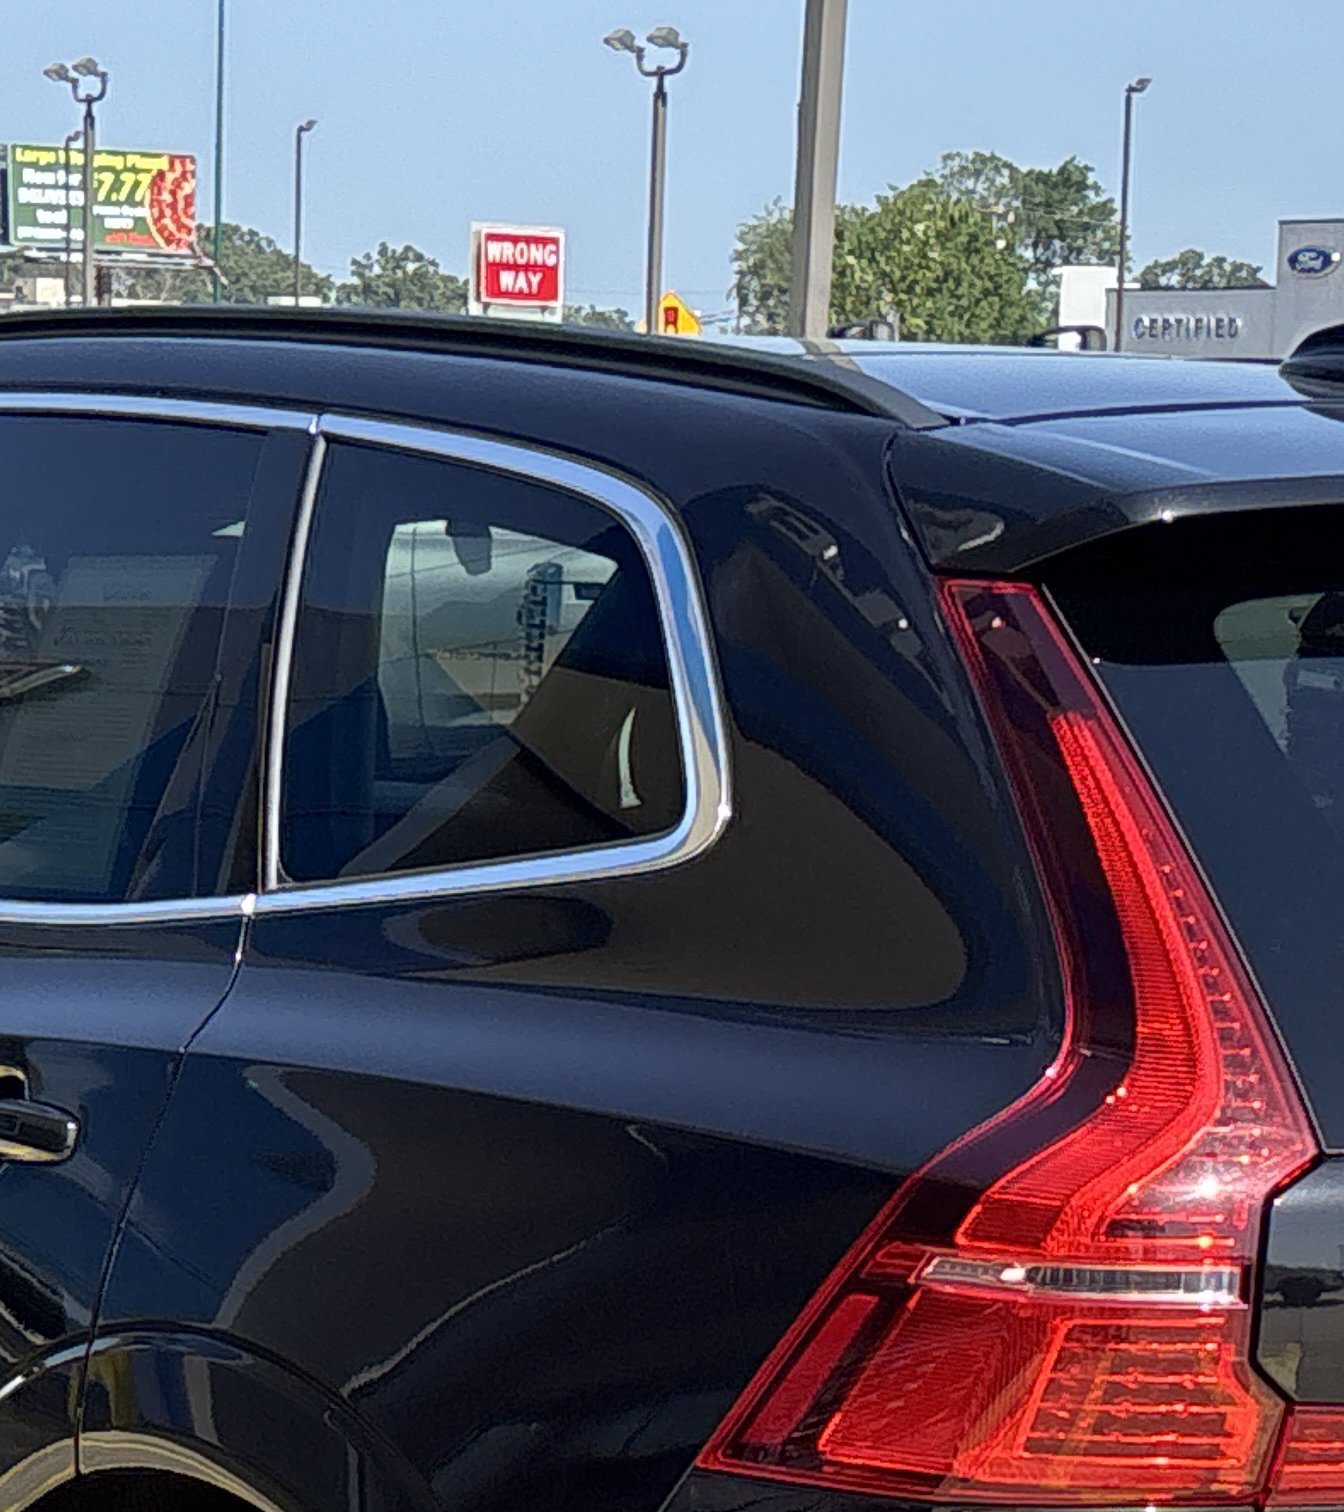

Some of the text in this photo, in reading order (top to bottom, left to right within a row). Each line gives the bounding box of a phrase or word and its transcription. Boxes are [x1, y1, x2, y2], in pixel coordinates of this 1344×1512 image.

[487, 240, 556, 266] WRONG
[499, 270, 543, 294] WAY
[1134, 317, 1239, 339] CERTIFIED
